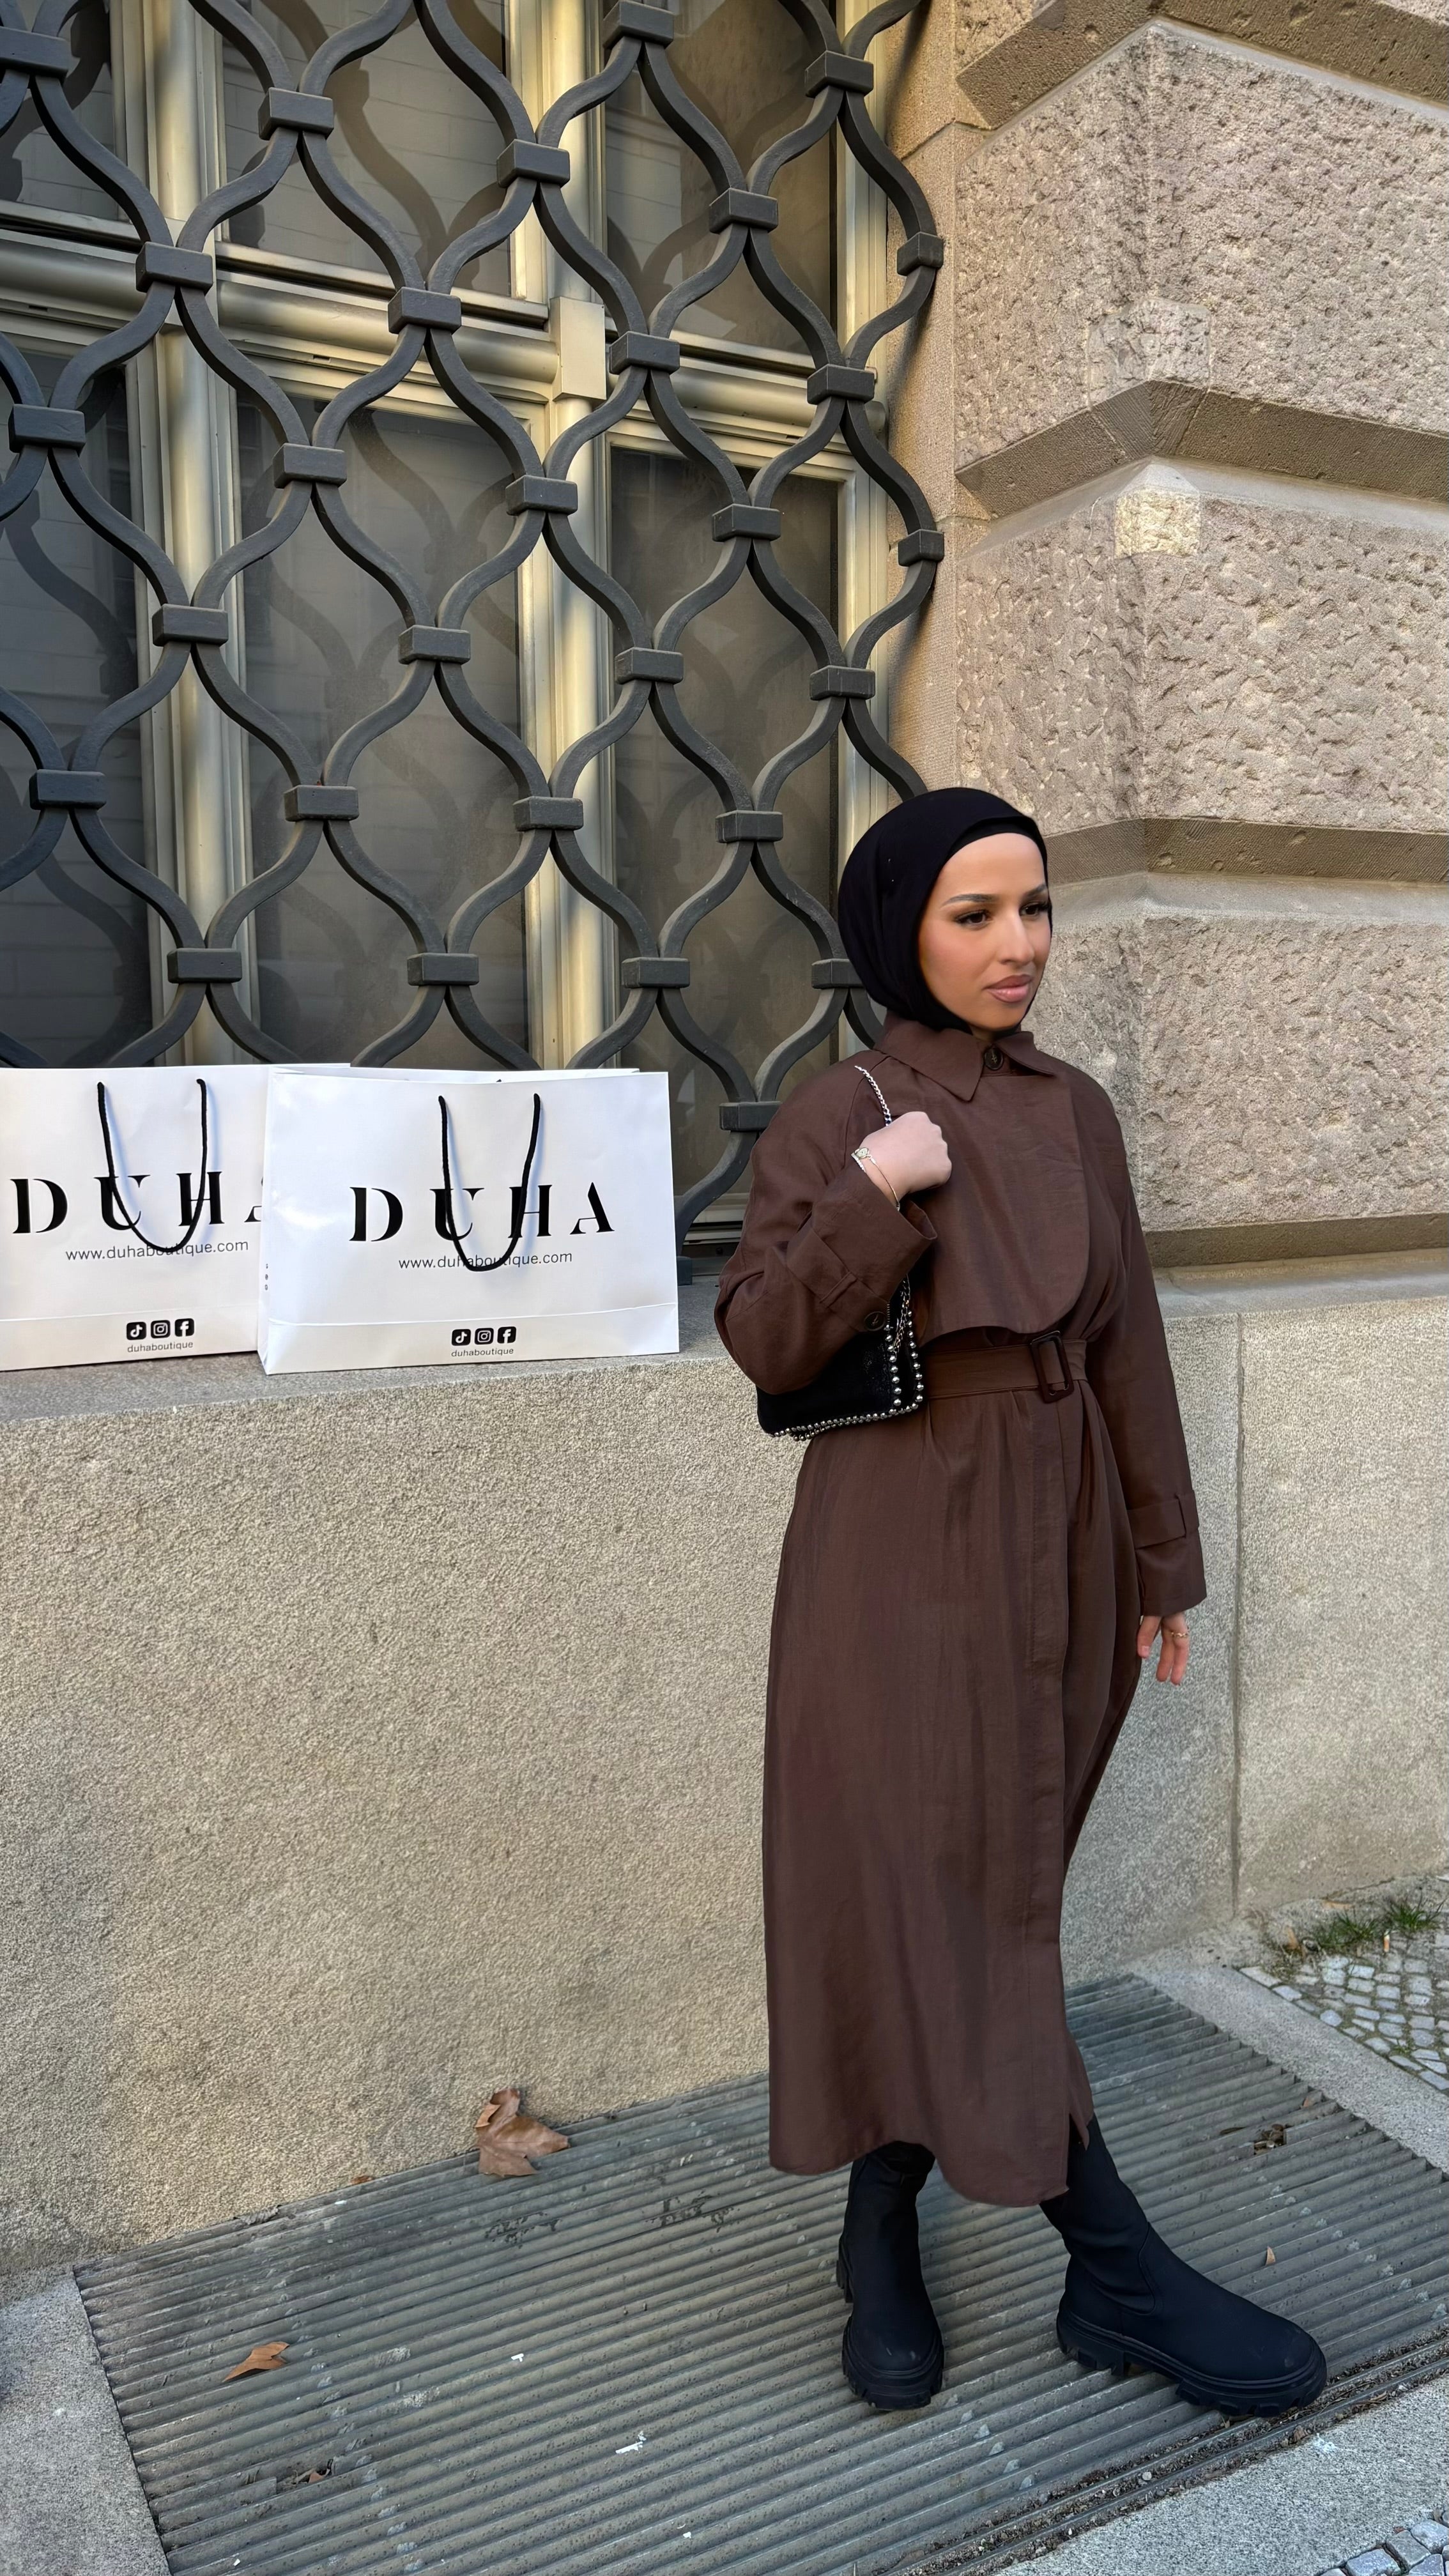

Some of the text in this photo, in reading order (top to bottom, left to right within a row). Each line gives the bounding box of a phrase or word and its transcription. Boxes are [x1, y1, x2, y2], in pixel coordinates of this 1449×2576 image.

[10, 1170, 264, 1234] DUH
[349, 1182, 615, 1242] DUHA
[127, 1342, 194, 1353] duhaboutique
[451, 1347, 514, 1357] duhaboutique
